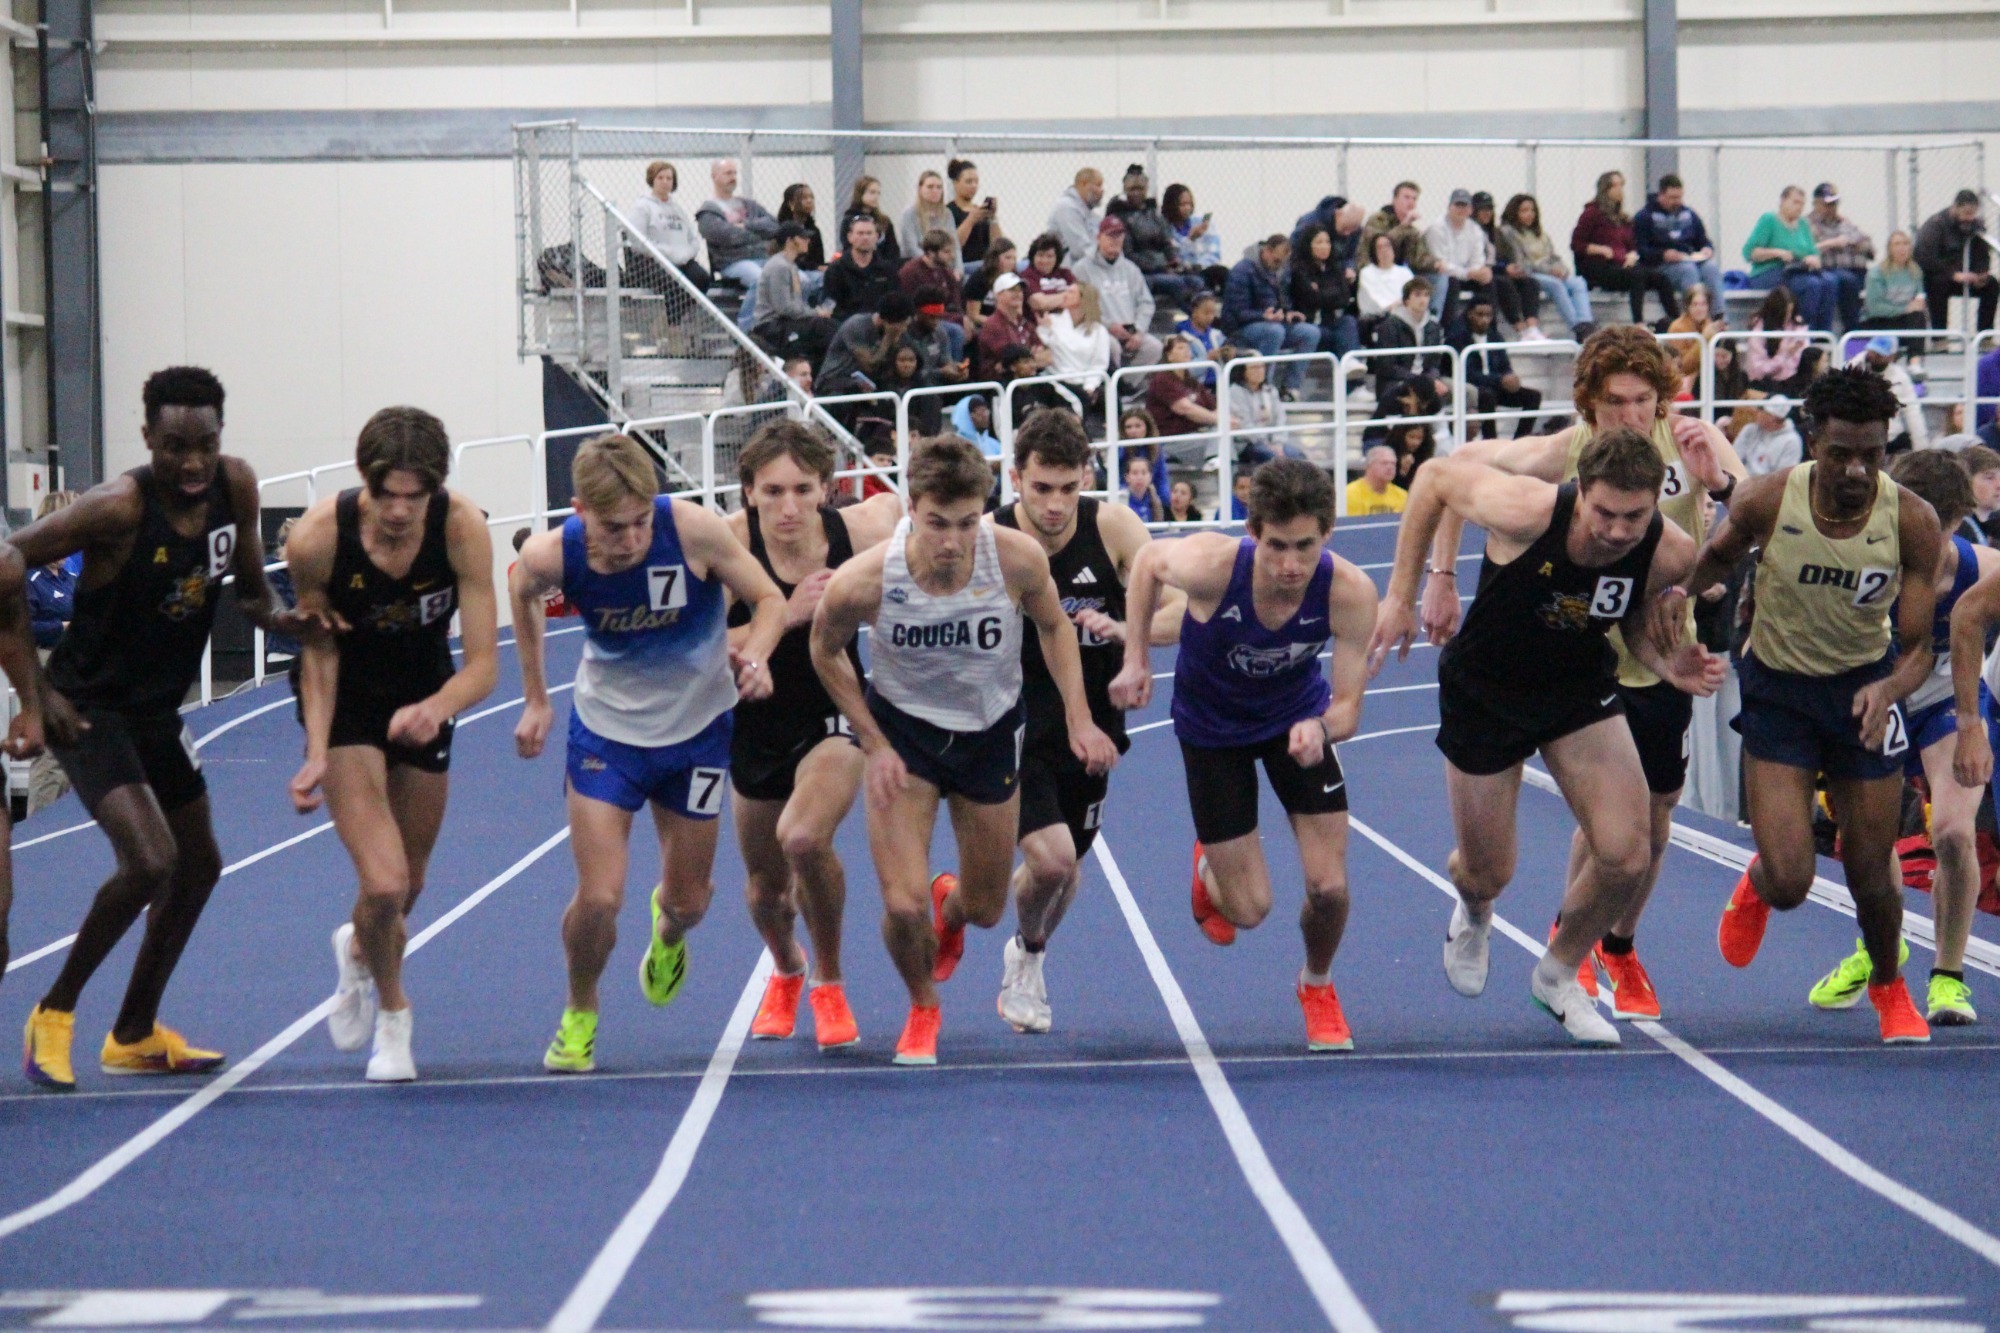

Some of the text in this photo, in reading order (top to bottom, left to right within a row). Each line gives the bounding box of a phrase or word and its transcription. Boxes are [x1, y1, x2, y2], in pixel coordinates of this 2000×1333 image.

[214, 531, 231, 570] 9
[653, 569, 678, 606] 7
[1596, 580, 1626, 615] 3
[1857, 572, 1889, 605] 2
[593, 604, 680, 632] Tulsa
[892, 620, 971, 648] COUGA
[977, 616, 1003, 651] 6
[1887, 709, 1906, 752] 2
[696, 771, 721, 811] 7
